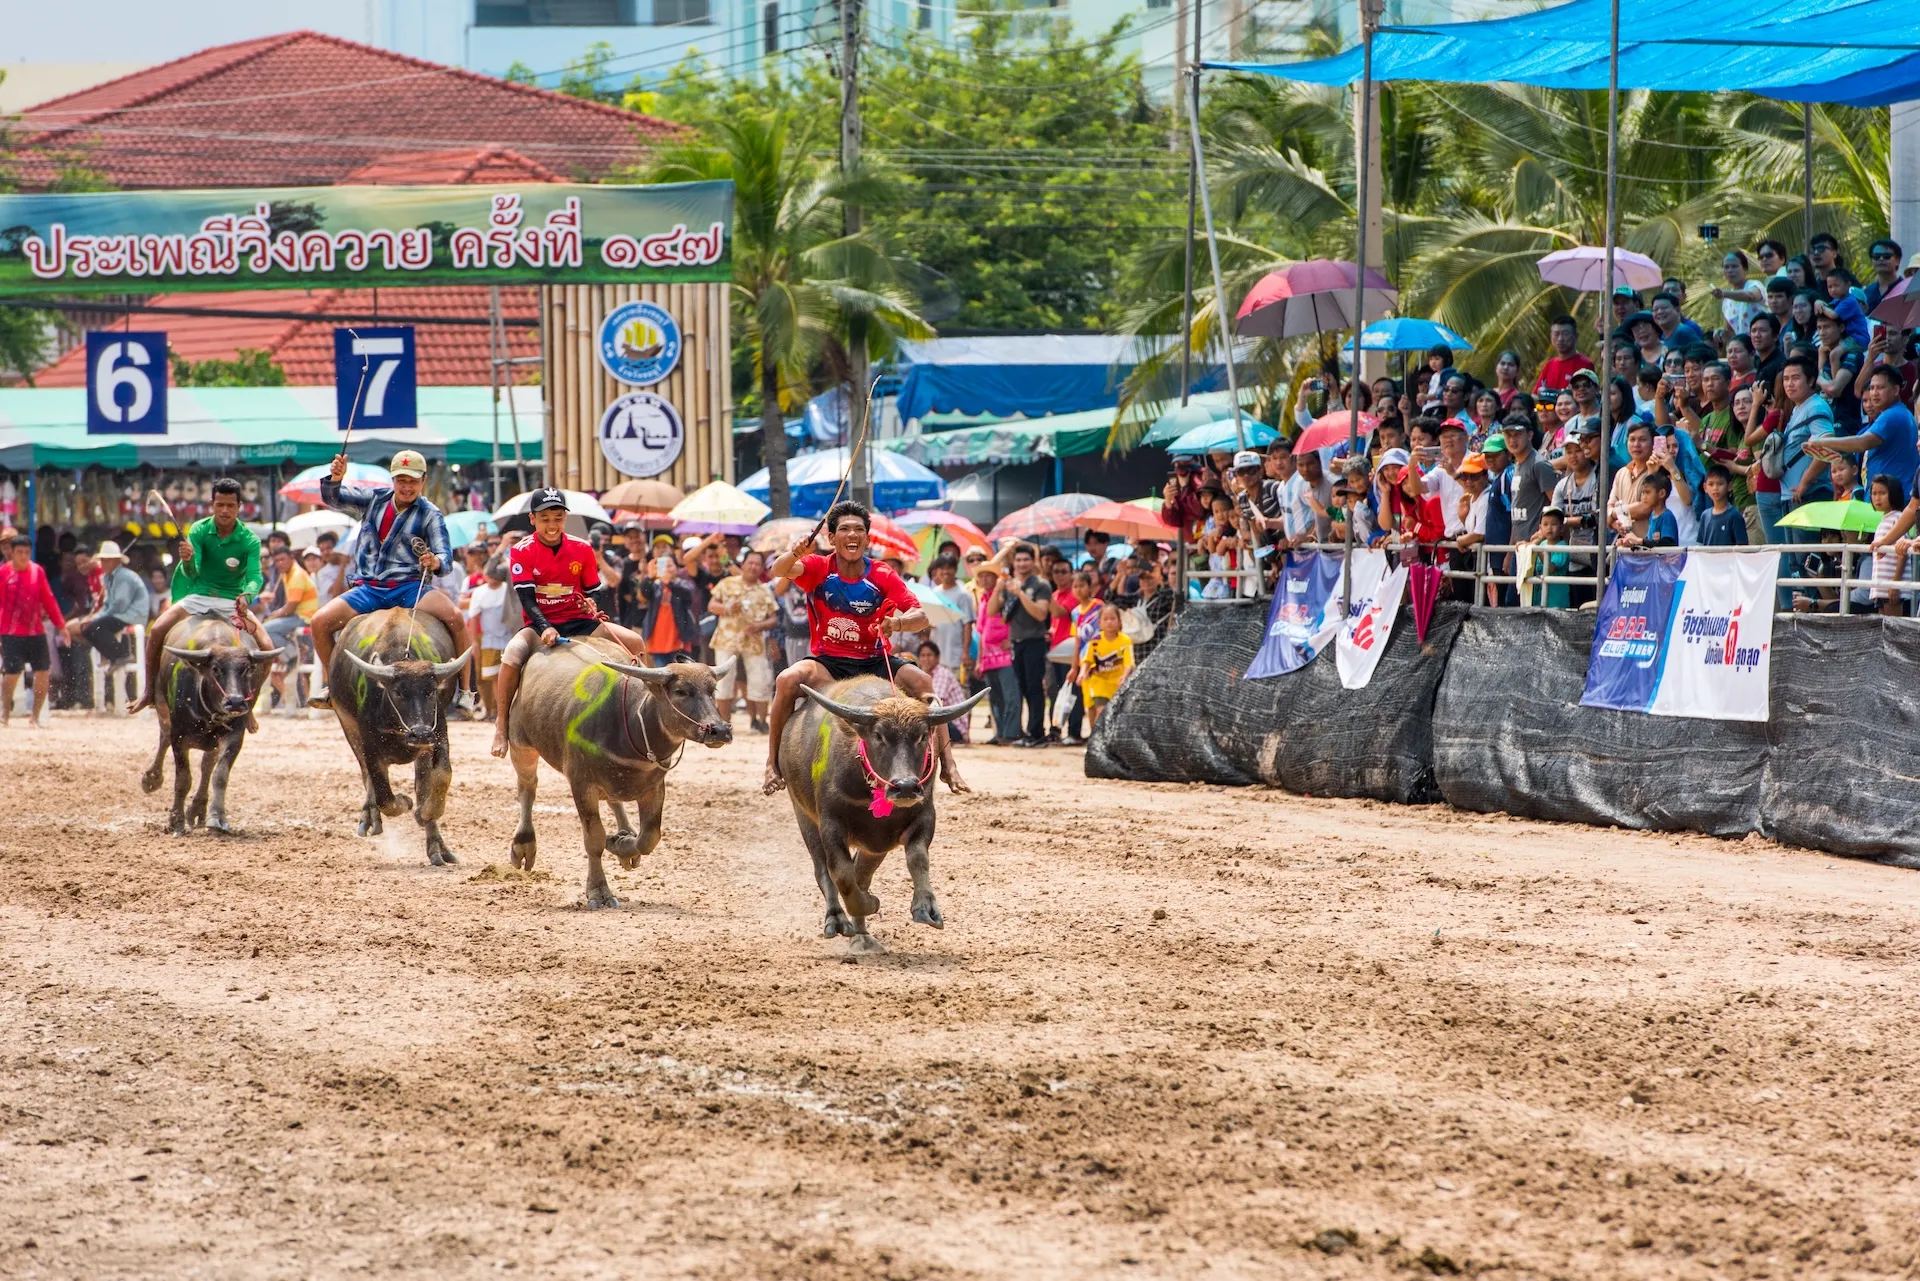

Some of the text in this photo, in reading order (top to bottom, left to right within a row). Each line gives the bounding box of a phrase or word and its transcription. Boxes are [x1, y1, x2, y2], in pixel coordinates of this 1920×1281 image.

[24, 193, 724, 277] ประเพณีวิ่งควาย ครั้งที่ ๑๔๗
[96, 341, 152, 423] 6
[352, 337, 404, 417] 7
